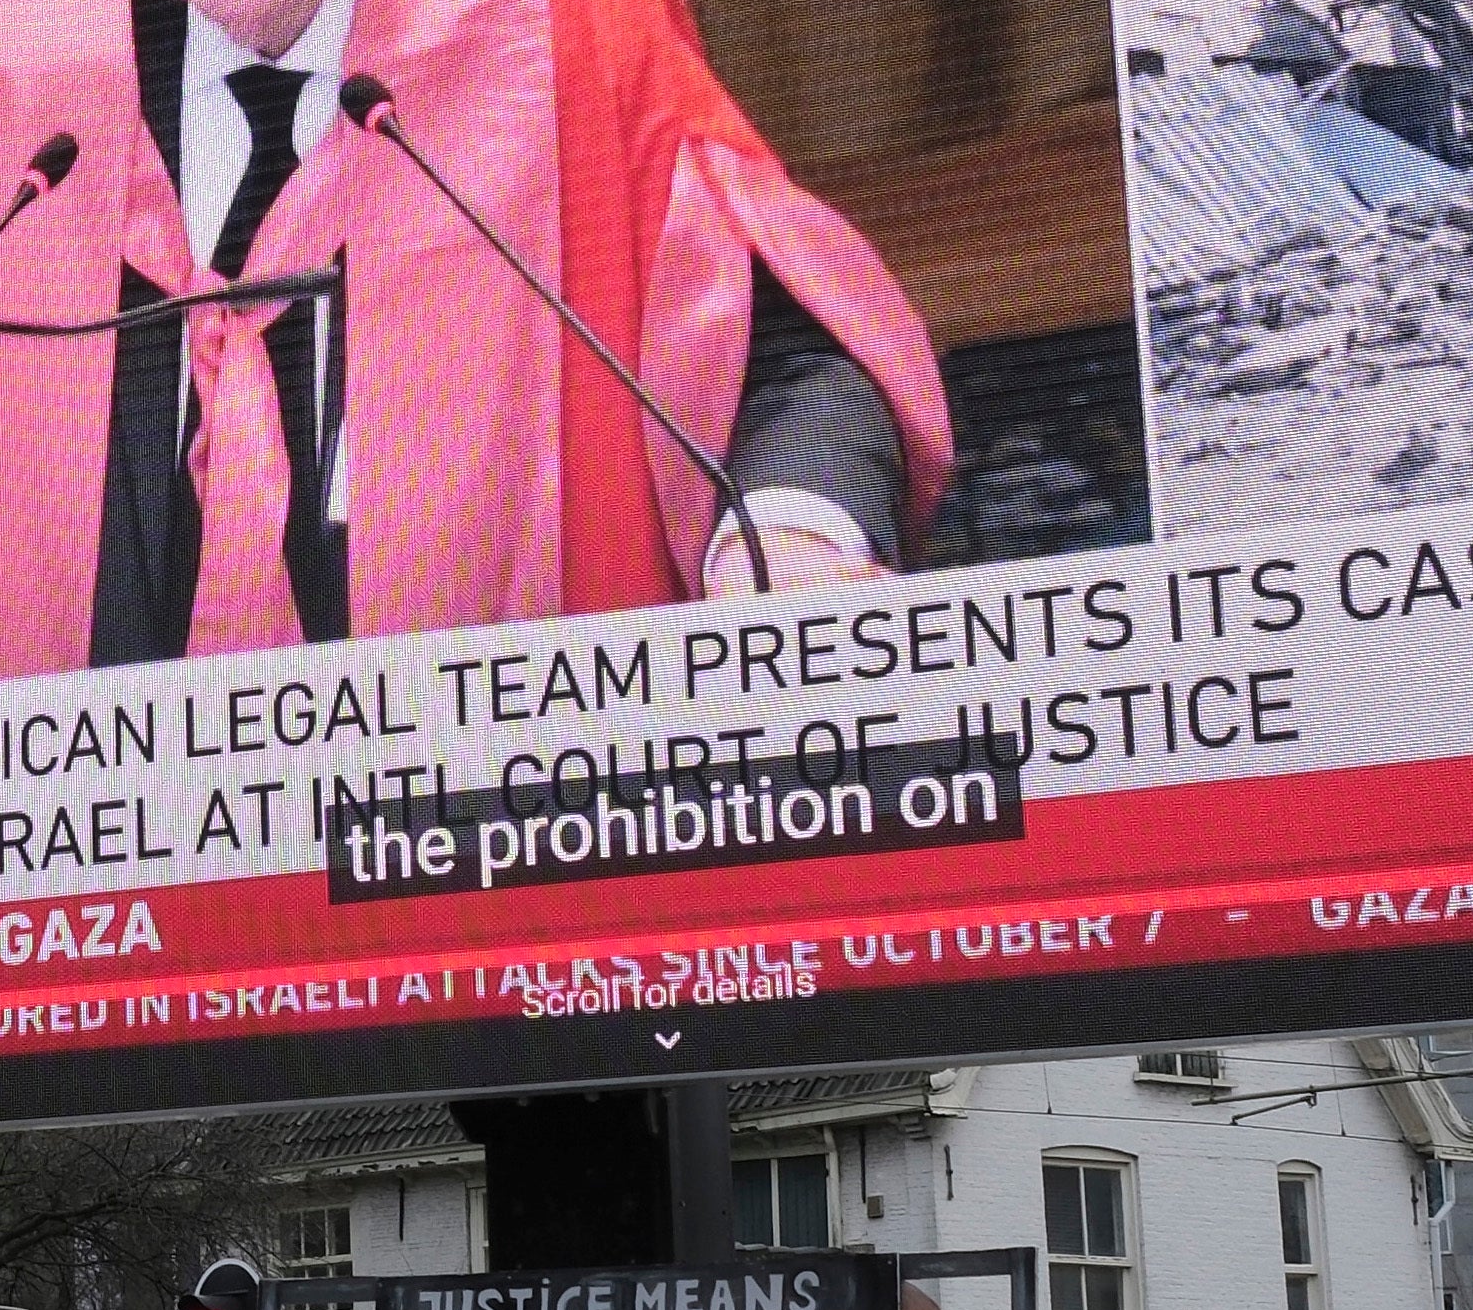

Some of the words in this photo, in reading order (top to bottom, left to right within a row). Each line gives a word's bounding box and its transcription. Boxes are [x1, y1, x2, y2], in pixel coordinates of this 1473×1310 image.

[185, 672, 415, 758] LEGAL
[438, 641, 650, 726] TEAM
[686, 580, 1133, 698] PRESENTS
[1169, 559, 1304, 643] ITS
[196, 782, 285, 854] AT
[505, 728, 764, 817] COURT
[796, 713, 900, 786] OF
[934, 668, 1300, 775] JUSTICE
[345, 816, 456, 882] the
[478, 775, 874, 889] prohibition
[900, 769, 997, 829] on
[125, 992, 171, 1028] IN
[188, 976, 378, 1022] ISRAELI
[693, 962, 818, 1006] details
